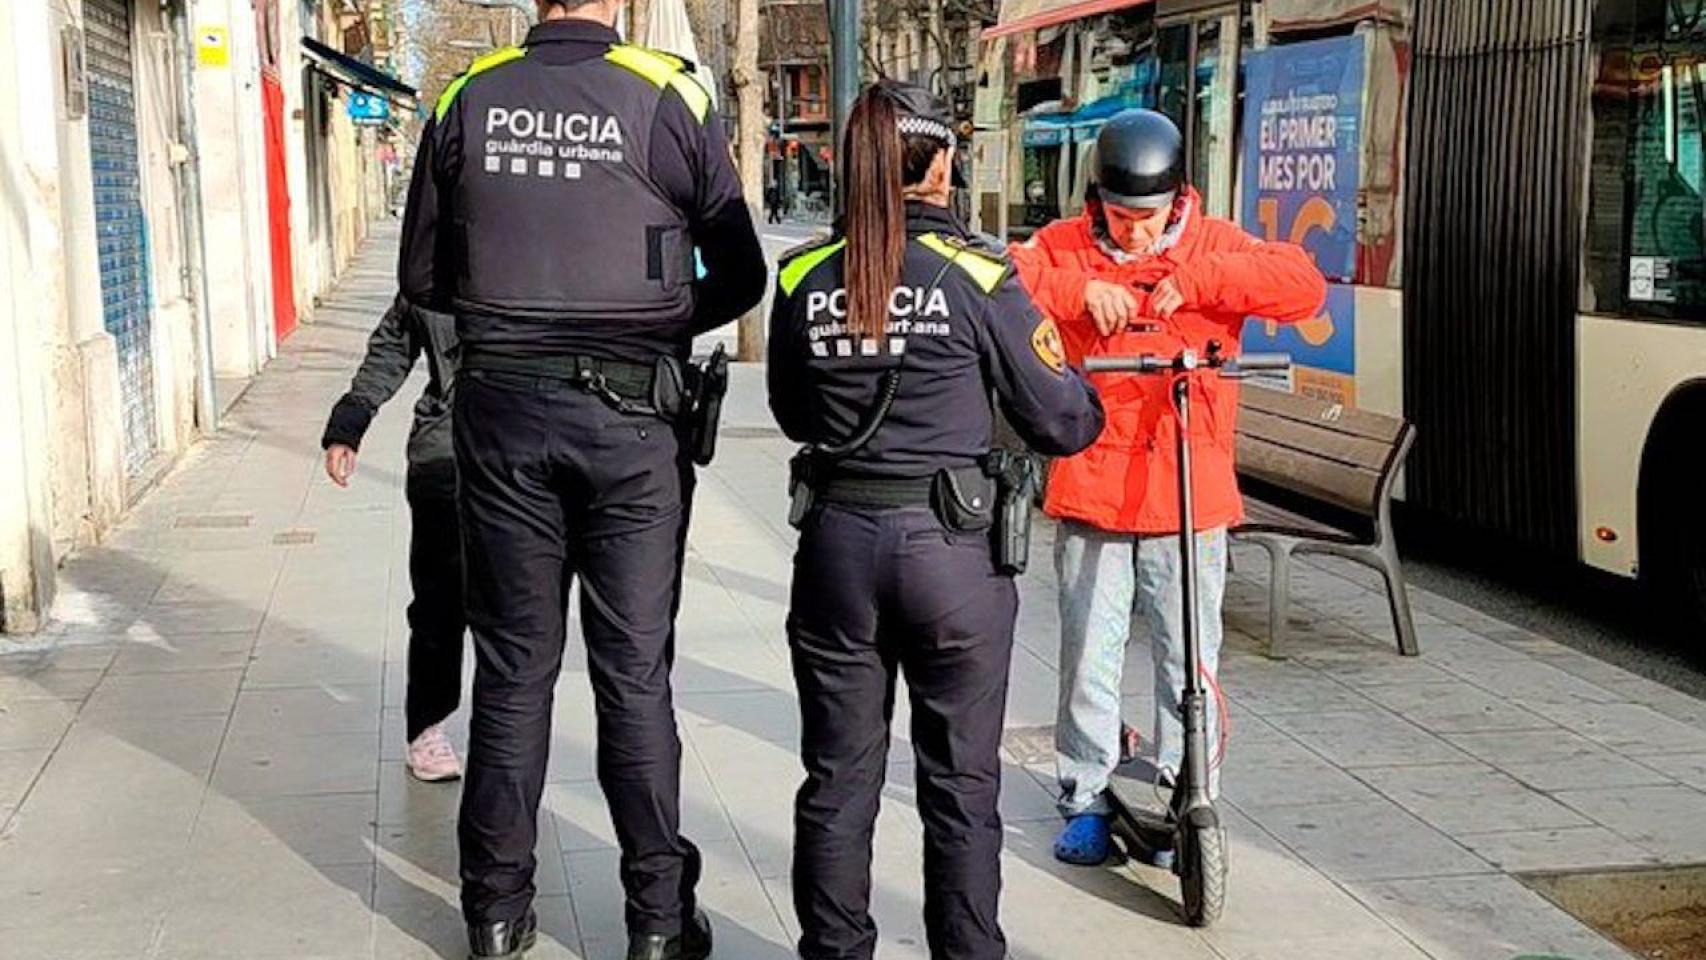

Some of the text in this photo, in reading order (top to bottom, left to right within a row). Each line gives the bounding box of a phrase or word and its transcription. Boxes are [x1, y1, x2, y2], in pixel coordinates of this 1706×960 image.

[487, 108, 623, 144] POLICIA
[1279, 114, 1336, 149] PRIMER
[486, 139, 623, 162] guàrdia urbana
[1258, 153, 1336, 190] MES POR
[807, 286, 949, 321] POCIA
